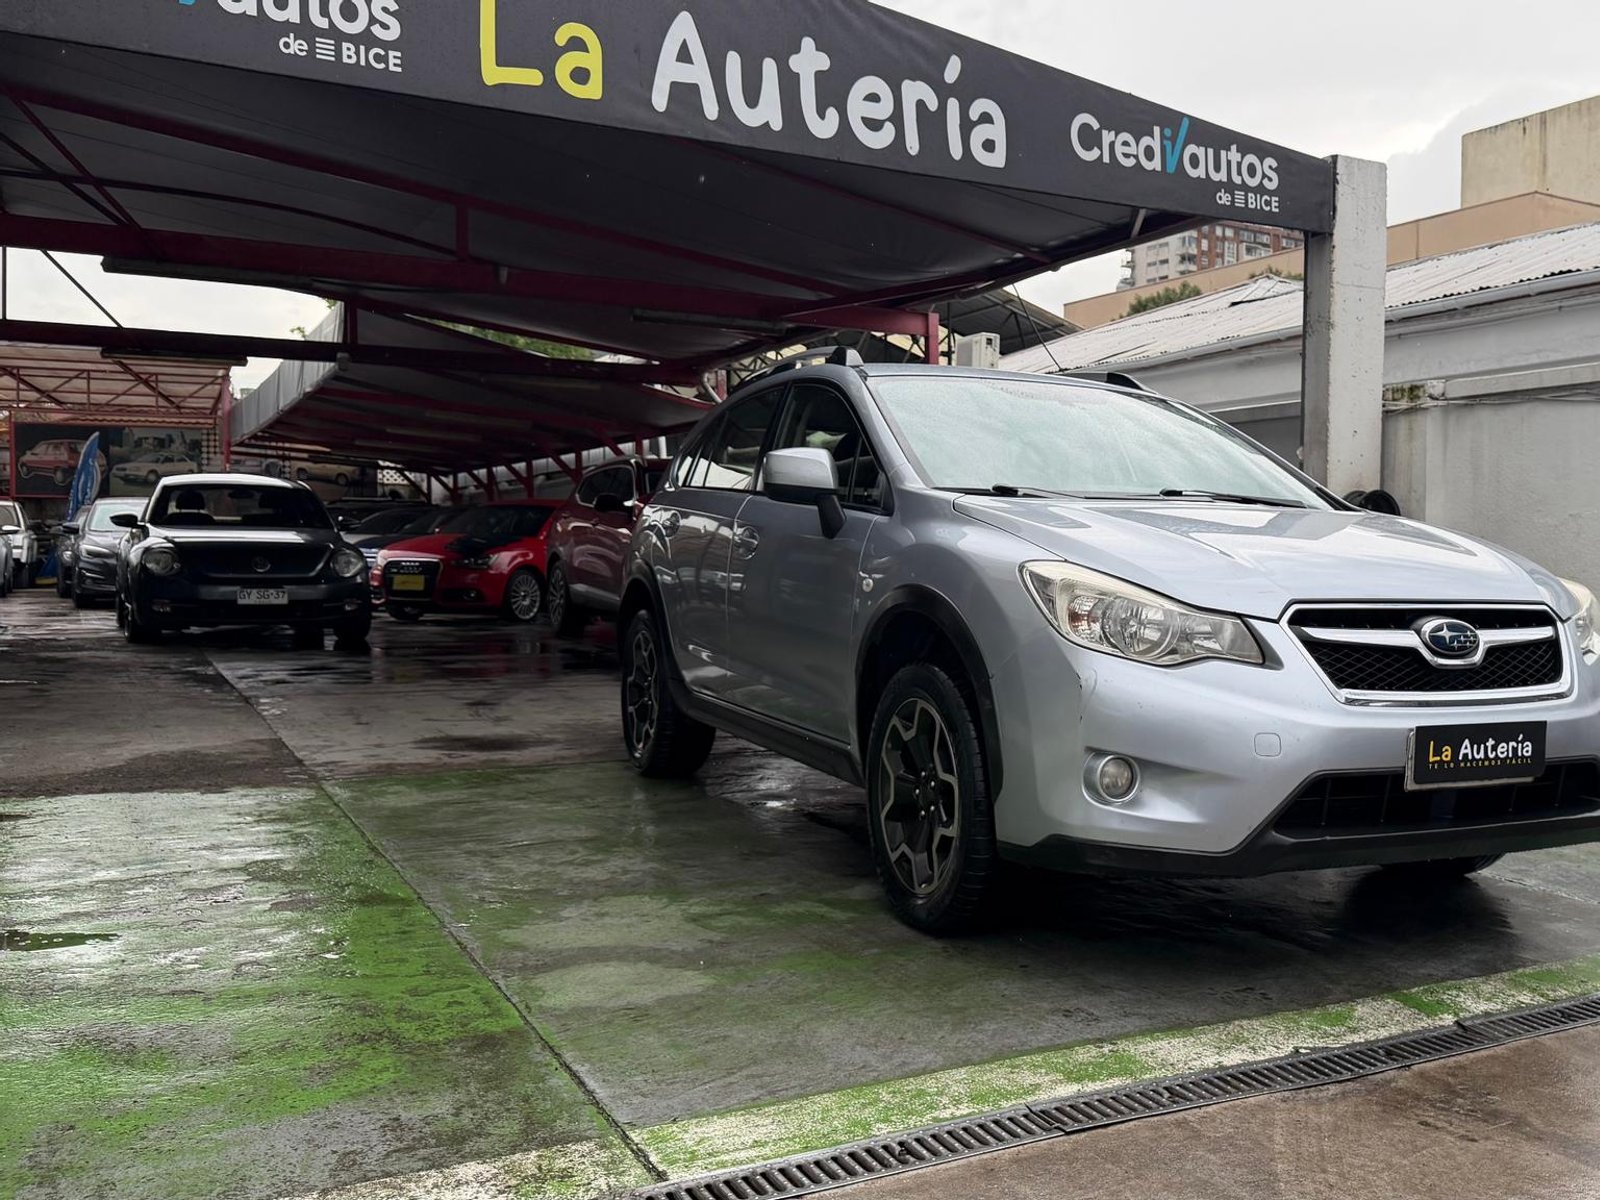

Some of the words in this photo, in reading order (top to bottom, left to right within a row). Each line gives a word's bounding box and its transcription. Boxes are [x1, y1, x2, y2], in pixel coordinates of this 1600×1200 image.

[278, 33, 309, 57] de
[341, 41, 403, 73] BICE
[479, 0, 603, 101] La
[650, 11, 1008, 169] Autería
[1216, 189, 1231, 206] de
[1247, 193, 1280, 213] BICE
[1429, 740, 1452, 762] La
[1459, 734, 1532, 760] Autería
